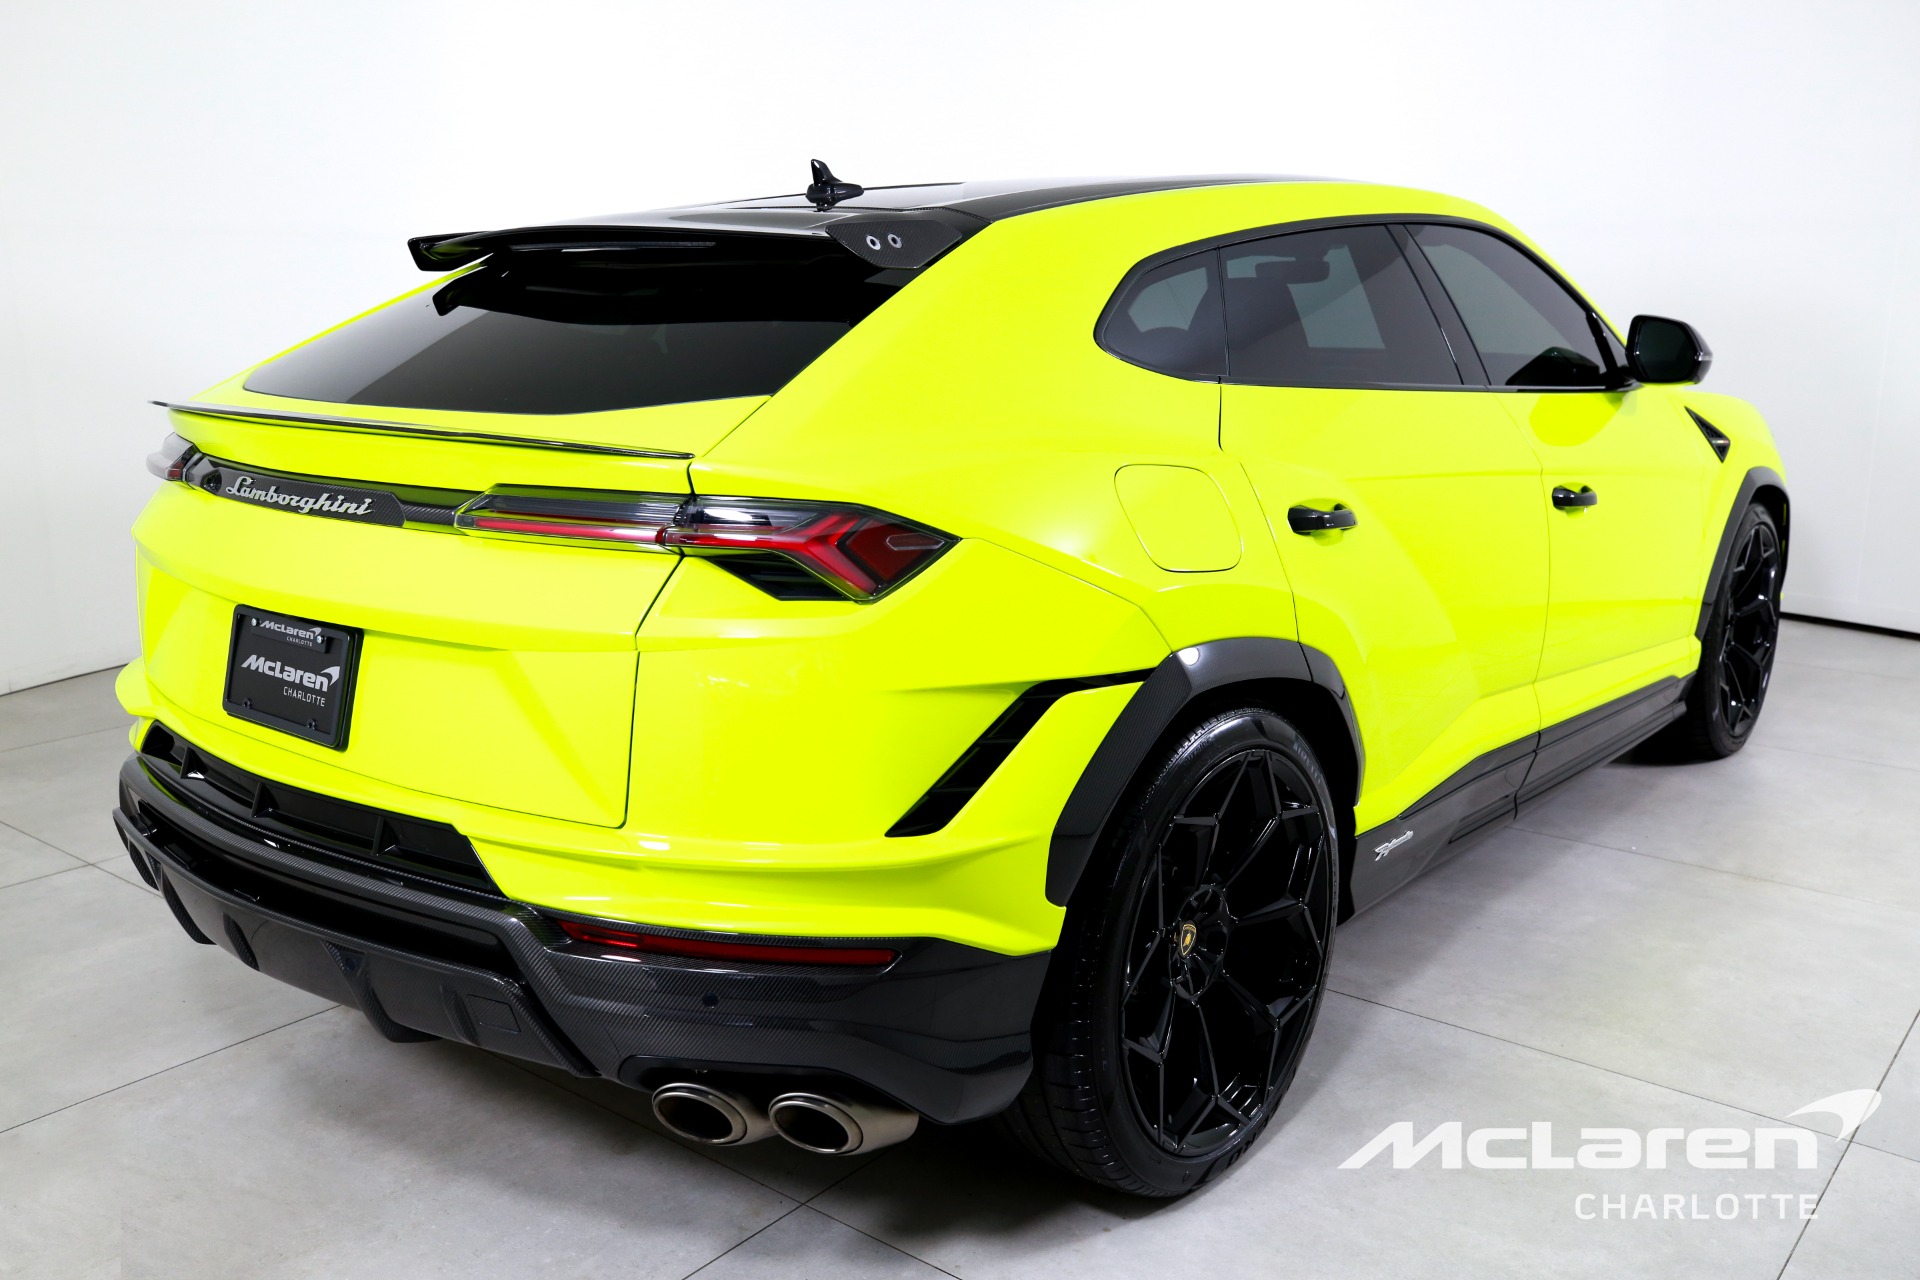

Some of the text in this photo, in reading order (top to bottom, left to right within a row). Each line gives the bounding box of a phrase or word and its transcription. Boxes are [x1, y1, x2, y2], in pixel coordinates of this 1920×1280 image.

[225, 476, 374, 515] Lamborghini
[260, 620, 315, 641] McLaren
[286, 636, 313, 647] CHARLOTTE
[241, 654, 329, 692] McLaren
[283, 686, 326, 707] CHARLOTTE
